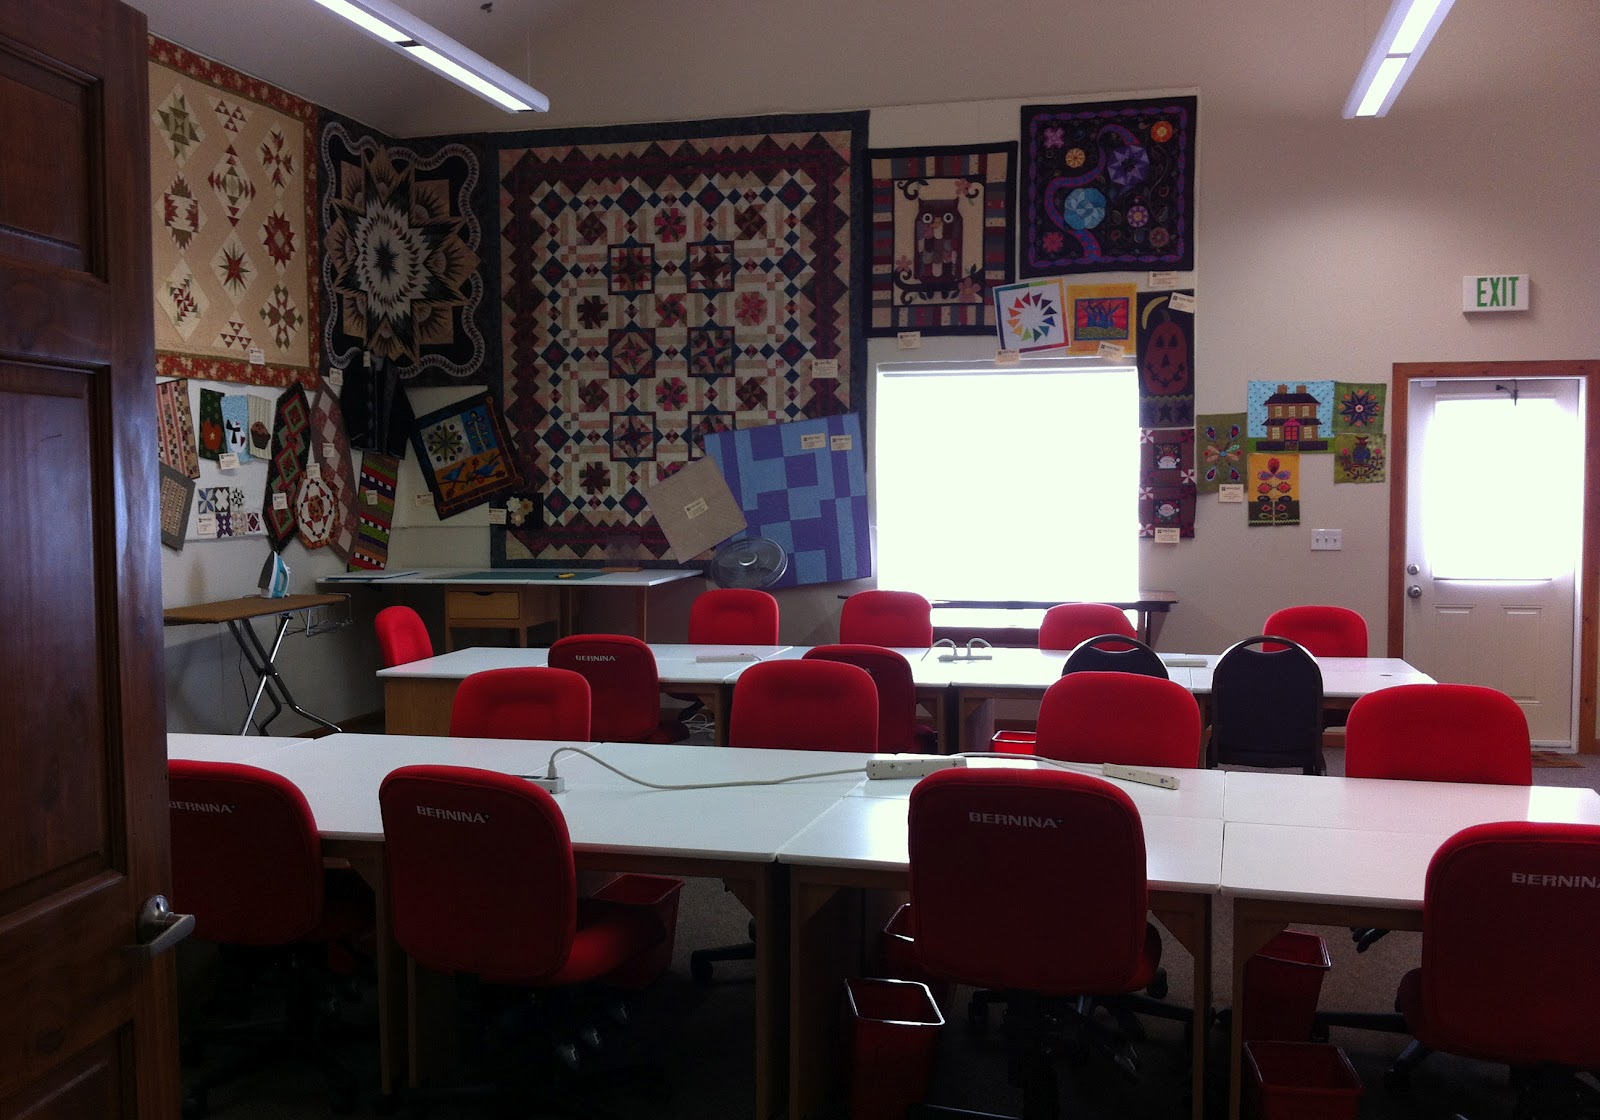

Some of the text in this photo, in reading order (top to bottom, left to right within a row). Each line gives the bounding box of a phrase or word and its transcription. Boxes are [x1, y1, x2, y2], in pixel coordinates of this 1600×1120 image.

[1477, 276, 1519, 306] EXIT
[575, 654, 616, 662] BERNINA
[168, 800, 233, 814] BERNINA
[416, 805, 486, 824] BERNINA
[968, 811, 1058, 829] BERNINA
